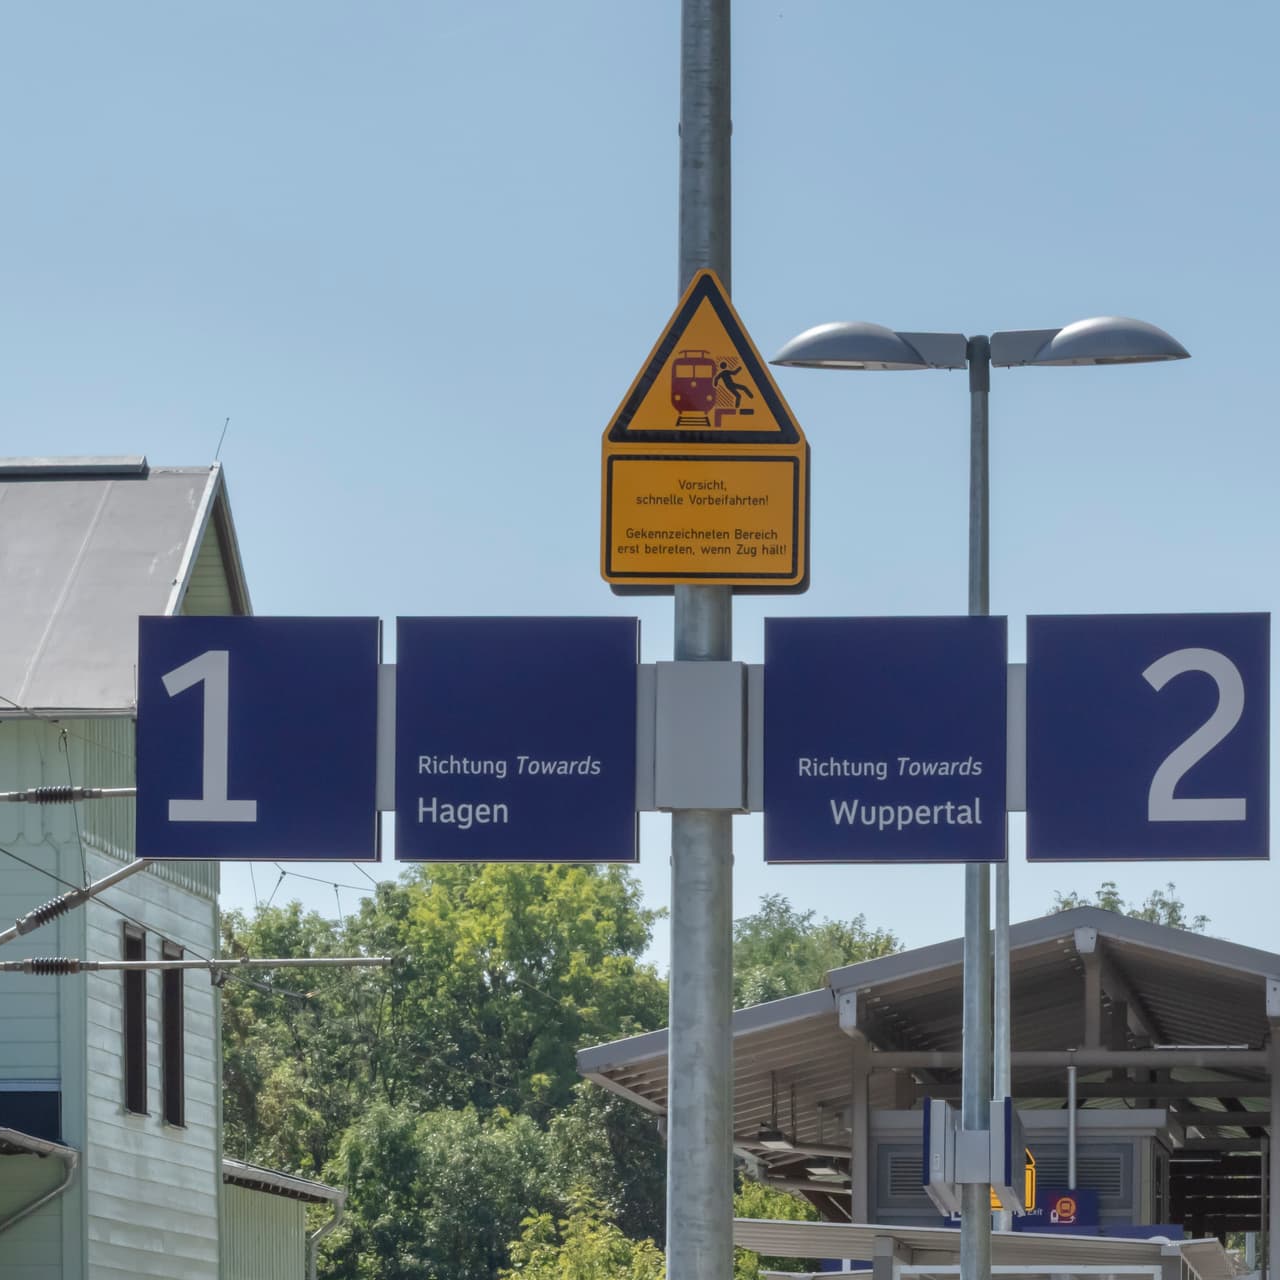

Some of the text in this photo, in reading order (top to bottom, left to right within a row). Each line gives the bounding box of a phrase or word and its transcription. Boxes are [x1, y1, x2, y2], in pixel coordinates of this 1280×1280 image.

[678, 480, 727, 491] Vorsicht,
[636, 494, 769, 506] schnelle Vorbeifahrten!
[625, 528, 778, 540] Gekennzeichneten Bereich
[617, 544, 787, 557] erst betreten, wenn Zug hält!
[161, 650, 257, 822] 1
[1142, 648, 1246, 821] 2
[418, 756, 601, 778] Richtung Towards
[798, 757, 982, 780] Richtung Towards
[418, 798, 509, 829] Hagen
[830, 798, 982, 830] Wuppertal
